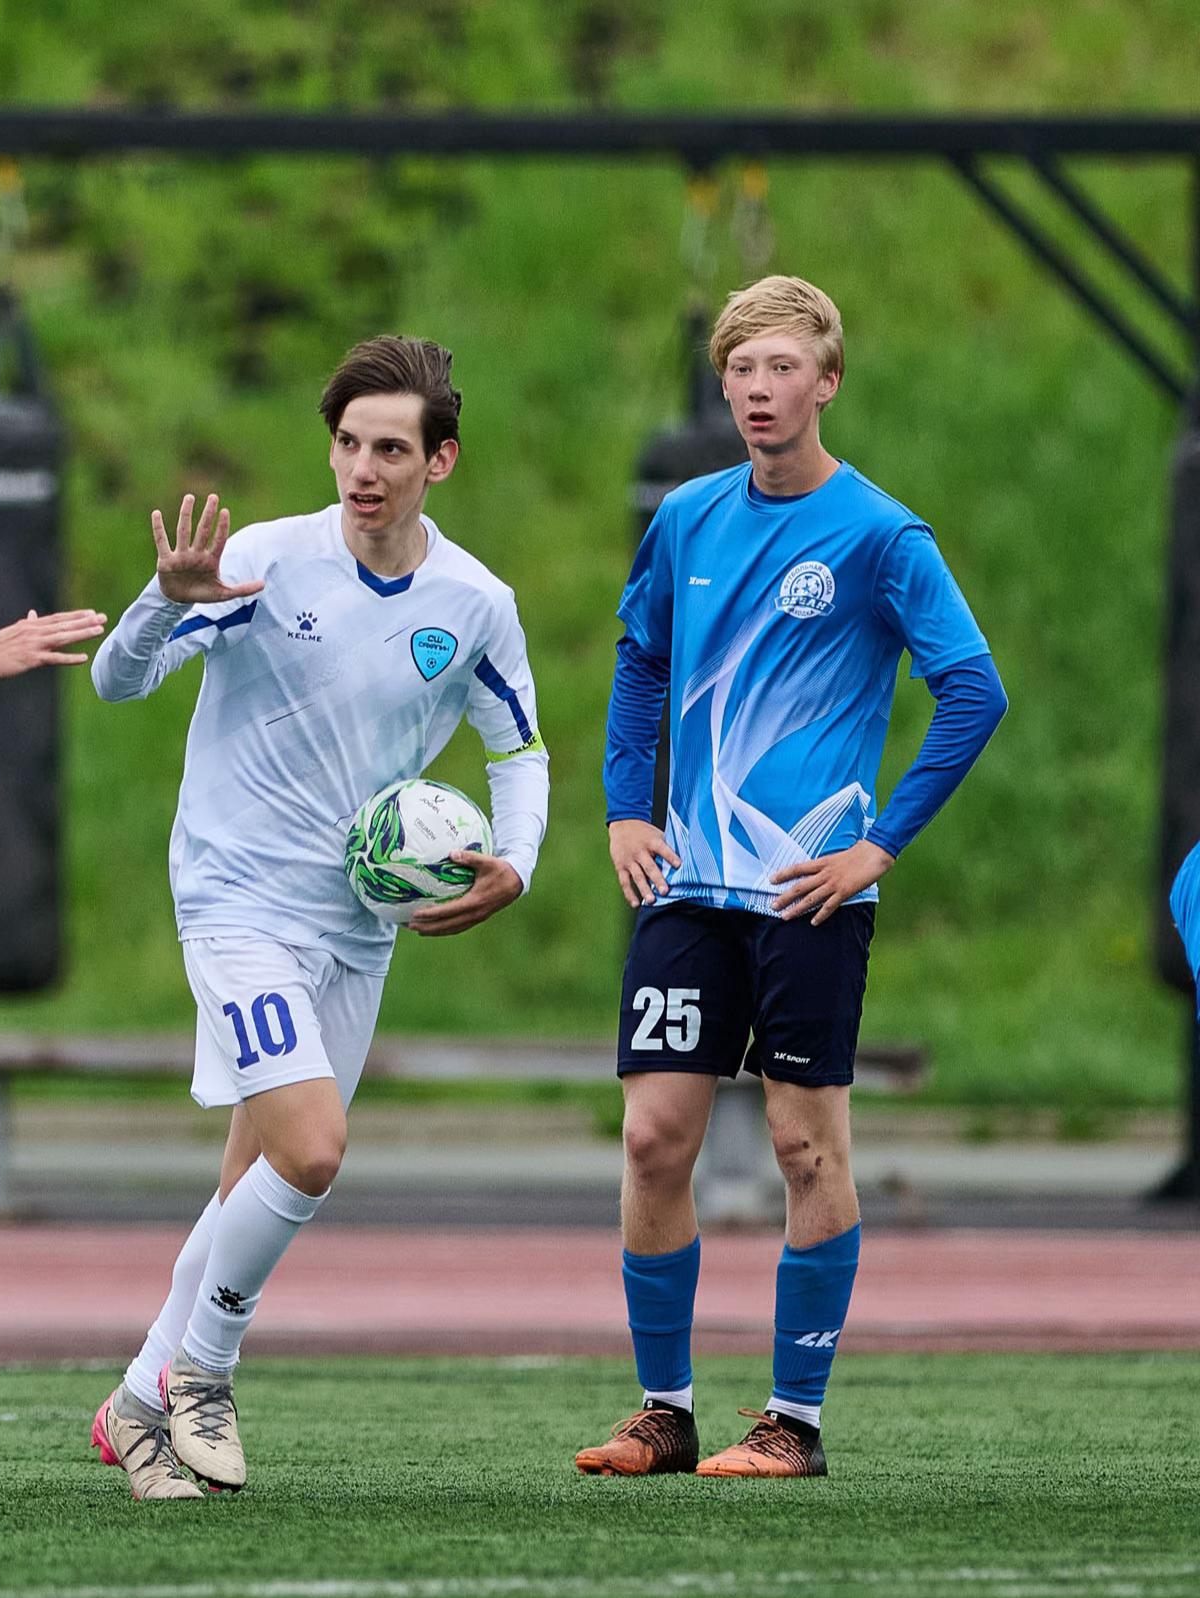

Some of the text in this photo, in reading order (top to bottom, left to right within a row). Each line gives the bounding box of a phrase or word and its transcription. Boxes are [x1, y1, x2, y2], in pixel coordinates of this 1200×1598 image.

[287, 631, 323, 643] KELME
[631, 986, 701, 1052] 25
[222, 992, 298, 1070] 10
[786, 1054, 811, 1064] SPORT
[210, 1294, 247, 1315] KELME
